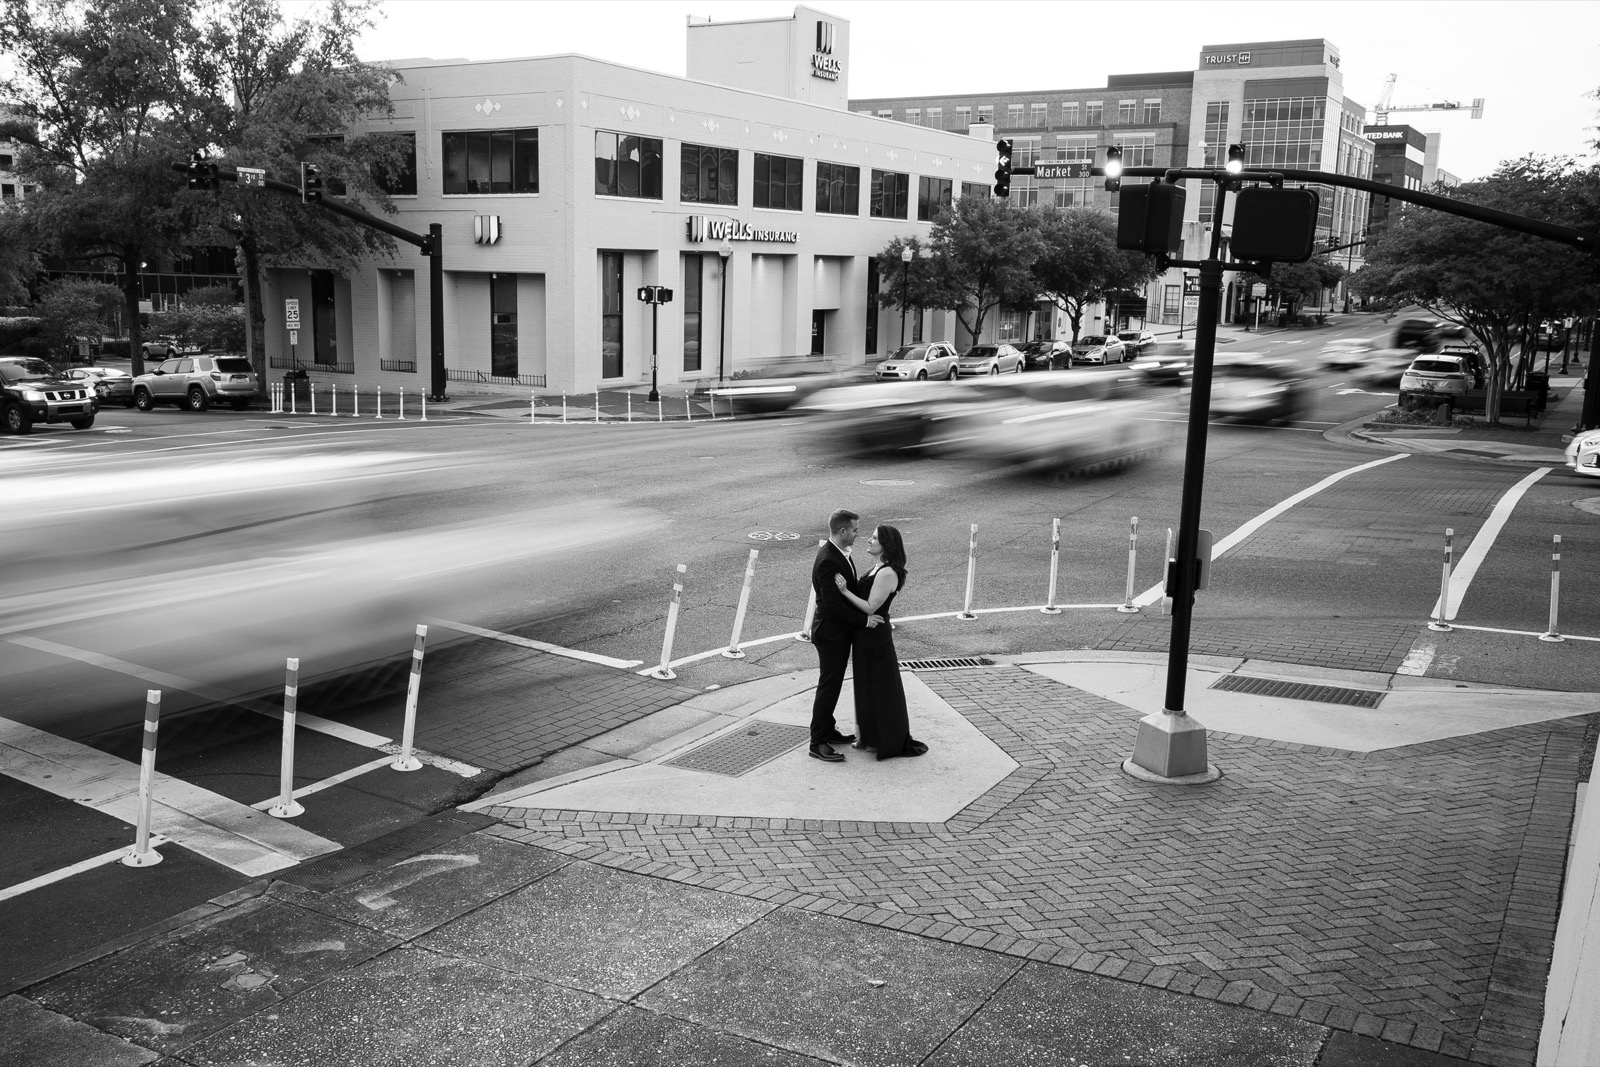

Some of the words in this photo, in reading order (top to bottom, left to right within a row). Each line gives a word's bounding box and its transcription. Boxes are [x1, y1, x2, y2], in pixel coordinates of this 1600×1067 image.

[811, 54, 842, 74] WELLS
[1204, 54, 1238, 64] TRUIST
[1383, 131, 1404, 139] BANK
[1036, 165, 1072, 178] Market
[1078, 170, 1090, 178] 300
[245, 173, 256, 184] 3rd
[709, 220, 754, 240] WELLS
[753, 230, 801, 242] INSURANCE
[287, 310, 299, 319] 25
